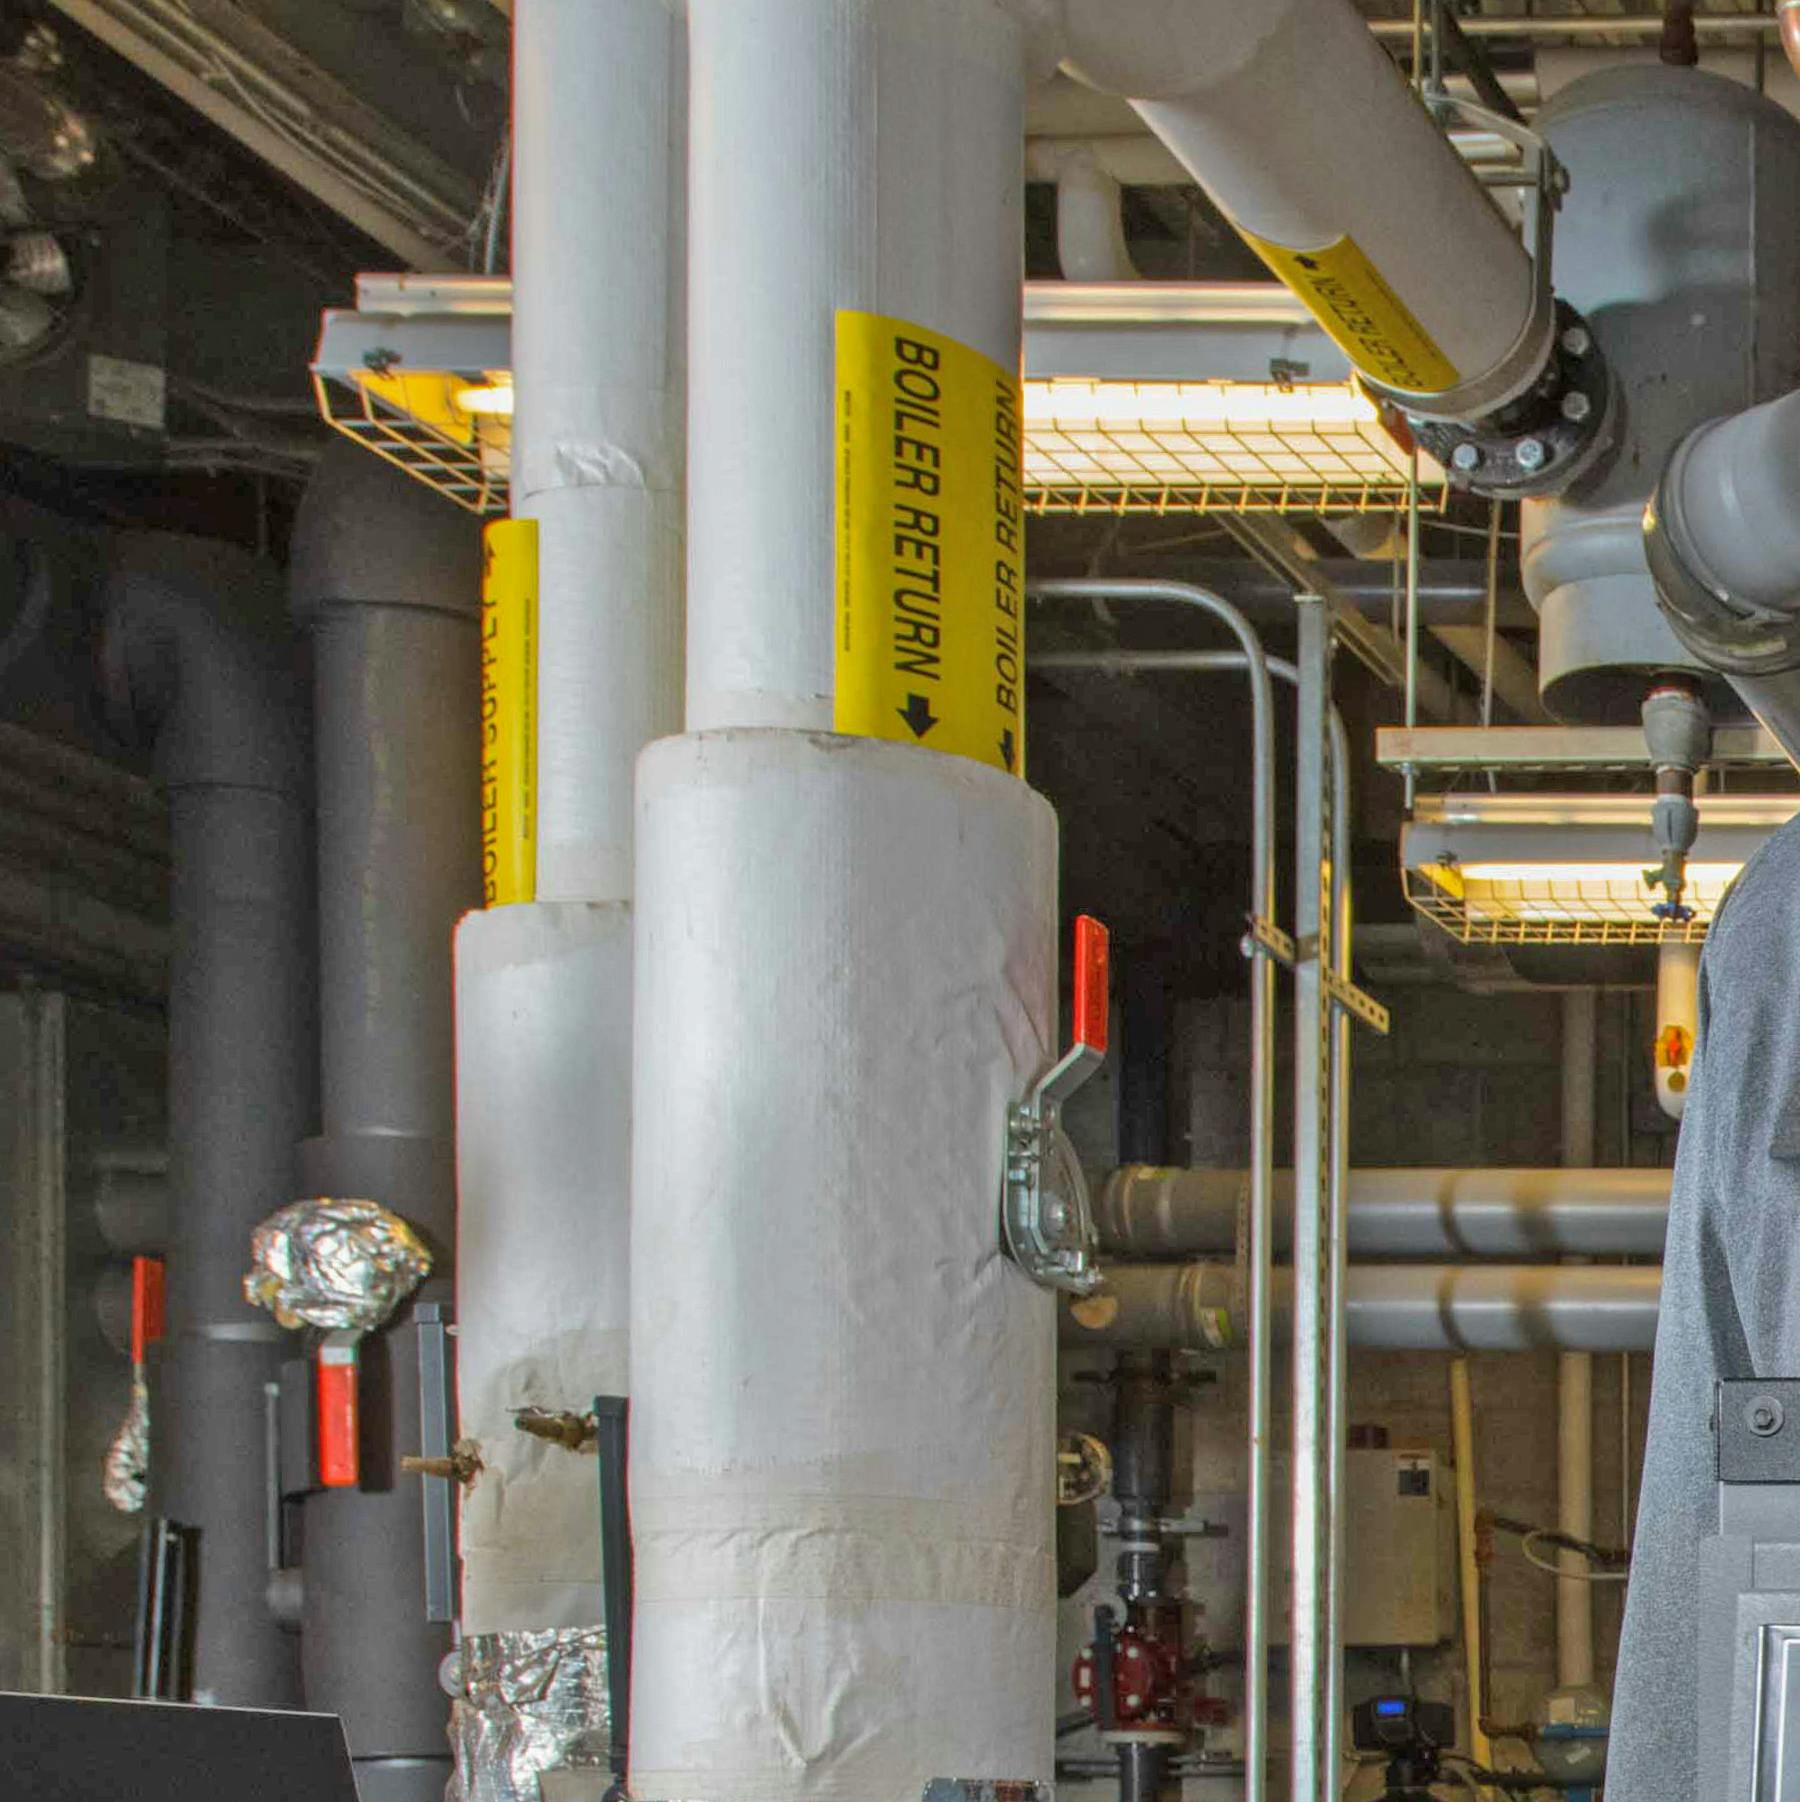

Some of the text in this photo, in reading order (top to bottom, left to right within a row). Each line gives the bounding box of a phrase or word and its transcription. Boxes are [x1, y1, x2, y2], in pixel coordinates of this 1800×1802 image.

[893, 336, 941, 682] BOILER RETURN
[995, 381, 1019, 717] BOILER RETURN
